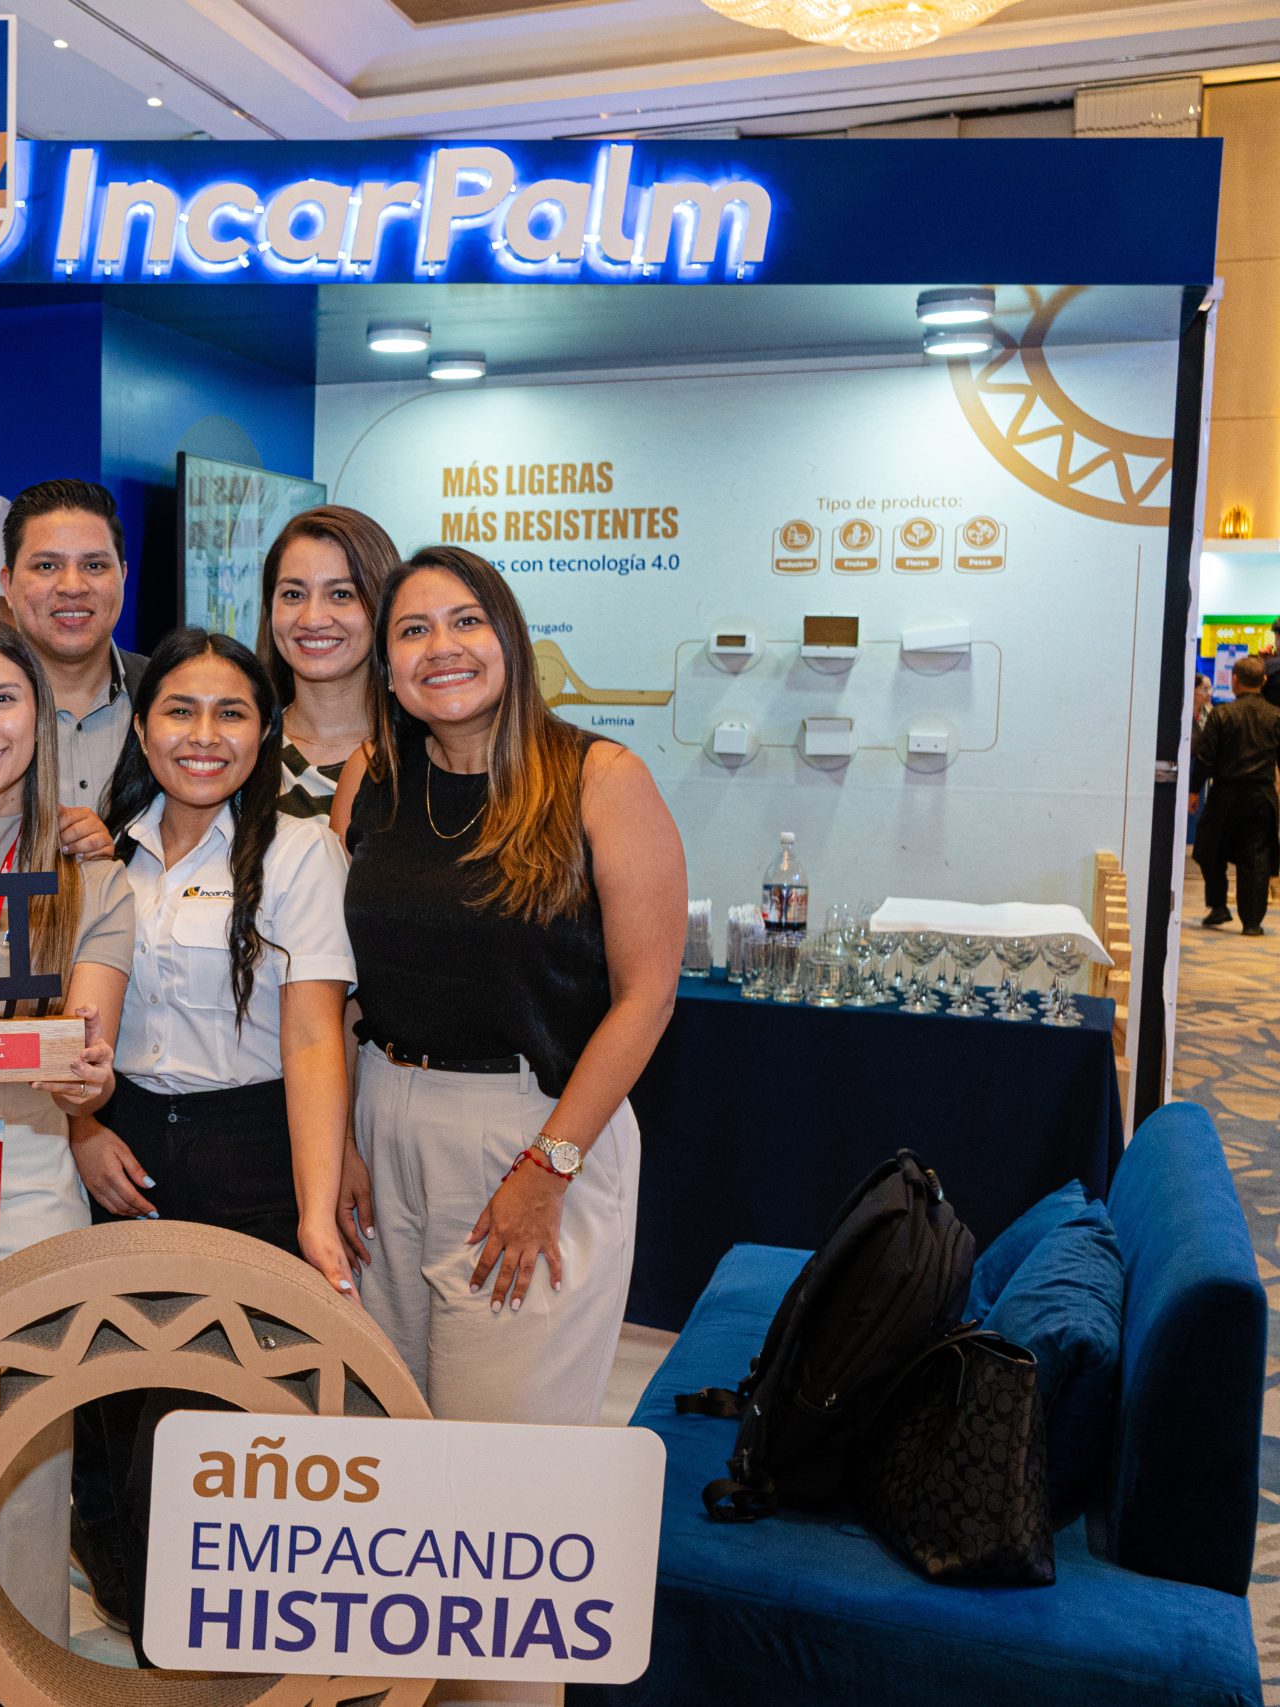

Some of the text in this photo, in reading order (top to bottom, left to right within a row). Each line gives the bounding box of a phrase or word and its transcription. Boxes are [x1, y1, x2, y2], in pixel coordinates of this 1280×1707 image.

[57, 144, 772, 263] IncarPalm
[442, 460, 613, 497] MÁS LIGERAS
[817, 495, 963, 513] Tipo de producto:
[441, 505, 679, 543] MÁS RESISTENTES
[511, 558, 543, 573] con
[549, 553, 646, 576] tecnología
[652, 554, 680, 572] 4.0
[591, 715, 635, 727] Lámina
[192, 1436, 381, 1503] años
[191, 1522, 596, 1582] EMPACANDO
[188, 1587, 614, 1661] HISTORIAS
